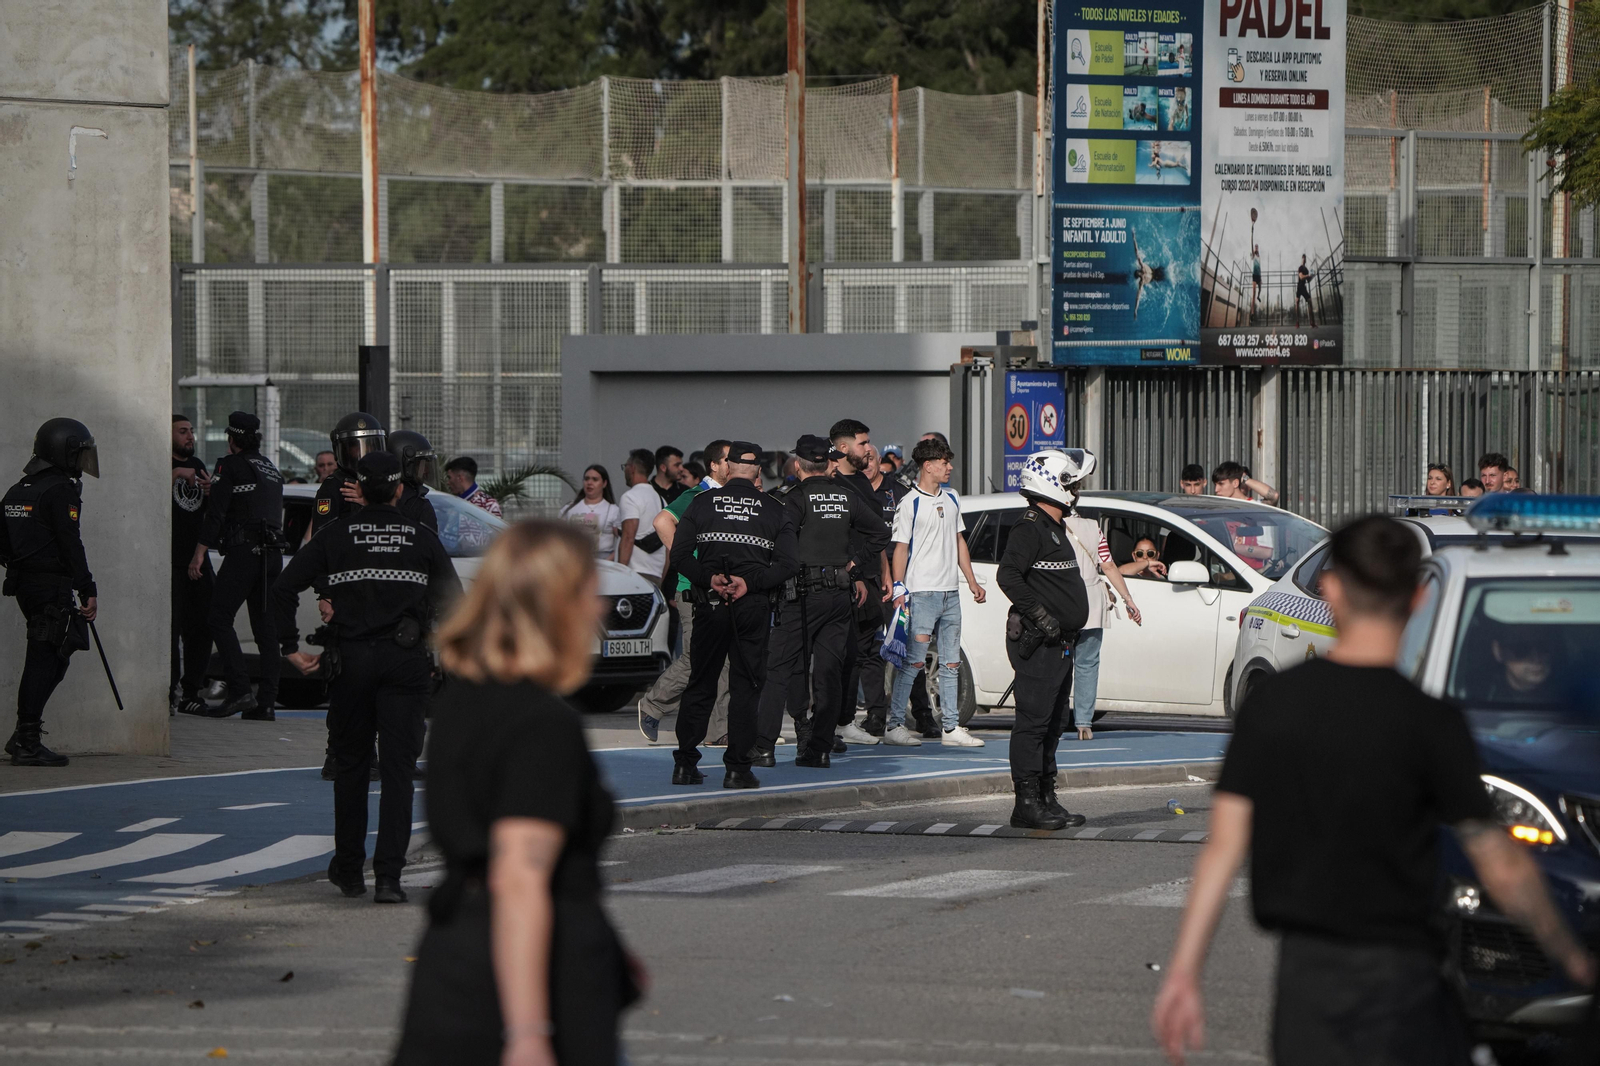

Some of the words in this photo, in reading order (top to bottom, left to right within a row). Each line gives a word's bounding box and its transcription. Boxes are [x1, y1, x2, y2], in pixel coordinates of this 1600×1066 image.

[1081, 7, 1103, 20] TODOS
[1104, 8, 1118, 21] LOS
[1118, 8, 1146, 22] NIVELES
[1148, 10, 1153, 22] Y
[1154, 10, 1180, 24] EDADES
[1159, 34, 1175, 42] INFANTIL
[1094, 42, 1112, 52] Escuela
[1094, 54, 1101, 63] de
[1102, 54, 1114, 64] Pádel
[1246, 50, 1272, 64] DESCARGA
[1274, 52, 1281, 64] LA
[1282, 52, 1292, 64] APP
[1293, 52, 1322, 65] PLAYTOMIC
[1260, 69, 1264, 82] Y
[1265, 70, 1288, 82] RESERVA
[1288, 70, 1308, 82] ONLINE
[1158, 88, 1174, 96] INFANTIL
[1094, 96, 1112, 106] Escuela
[1232, 92, 1246, 104] LUNES
[1247, 93, 1250, 104] A
[1250, 93, 1270, 104] DOMINGO
[1270, 94, 1290, 105] DURANTE
[1290, 94, 1300, 105] TODO
[1300, 94, 1306, 105] EL
[1306, 92, 1316, 106] AÑO
[1094, 108, 1100, 118] de
[1101, 108, 1121, 118] Natación
[1094, 151, 1111, 160] Escuela
[1112, 152, 1118, 160] de
[1094, 162, 1126, 172] Matronatación
[1214, 163, 1245, 175] CALENDARIO
[1246, 164, 1254, 175] DE
[1254, 164, 1287, 176] ACTIVIDADES
[1288, 164, 1295, 176] DE
[1296, 162, 1311, 176] PÁDEL
[1312, 164, 1325, 176] PARA
[1326, 165, 1332, 177] EL
[1221, 180, 1238, 192] CURSO
[1238, 180, 1258, 192] 2023/24
[1260, 180, 1289, 192] DISPONIBLE
[1290, 180, 1296, 192] EN
[1297, 178, 1326, 192] RECEPCIÓN
[1063, 217, 1070, 228] DE
[1071, 218, 1105, 229] SEPTIEMBRE
[1105, 218, 1110, 228] A
[1110, 218, 1126, 229] JUNIO
[1063, 230, 1093, 243] INFANTIL
[1094, 230, 1100, 243] Y
[1100, 230, 1126, 243] ADULTO
[1218, 334, 1231, 346] 687
[1232, 334, 1246, 346] 628
[1247, 334, 1259, 346] 257
[1265, 334, 1278, 346] 956
[1280, 334, 1293, 346] 320
[1294, 335, 1308, 346] 820
[1166, 348, 1191, 361] WOW!
[1236, 346, 1290, 357] www.corner4.es
[1010, 413, 1025, 440] 30
[713, 496, 762, 507] POLICIA
[809, 494, 848, 502] POLICIA
[715, 504, 759, 516] LOCAL
[814, 504, 848, 512] LOCAL
[349, 524, 415, 535] POLICIA
[354, 535, 413, 546] LOCAL
[610, 641, 631, 654] 6930
[634, 641, 650, 654] LTH
